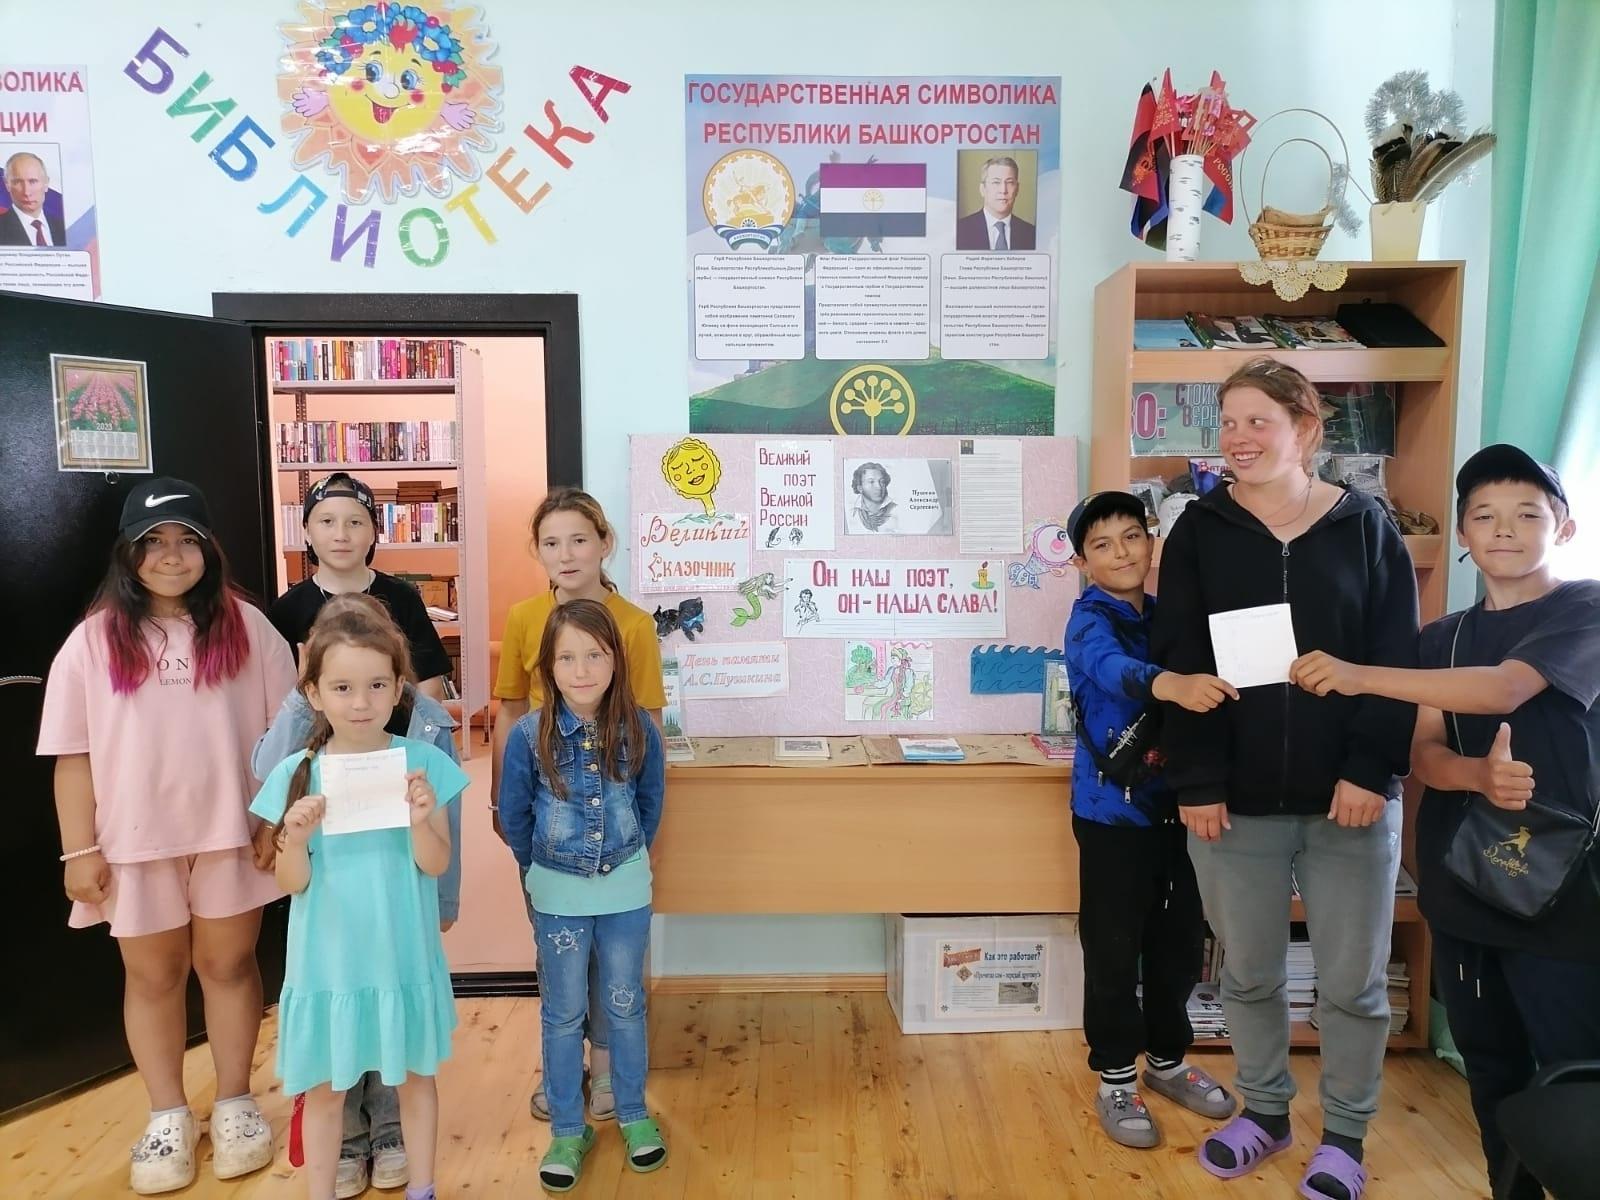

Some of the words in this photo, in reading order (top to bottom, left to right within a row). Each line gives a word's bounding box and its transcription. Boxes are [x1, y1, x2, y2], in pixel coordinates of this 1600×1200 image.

[688, 82, 911, 107] ГОСУДАРСТВЕННАЯ
[917, 83, 1057, 105] СИМВОЛИКА
[703, 122, 851, 145] РЕСПУБЛИКИ
[858, 123, 1041, 145] БАШКОРТОСТАН
[123, 27, 632, 269] БИБЛИОТЕКА
[96, 422, 113, 431] 2023
[640, 515, 750, 547] Великий
[682, 654, 719, 669] День
[721, 652, 780, 667] памяти
[160, 678, 192, 686] LEMON
[984, 951, 996, 961] Как
[998, 953, 1008, 961] это
[1008, 951, 1041, 963] работает?
